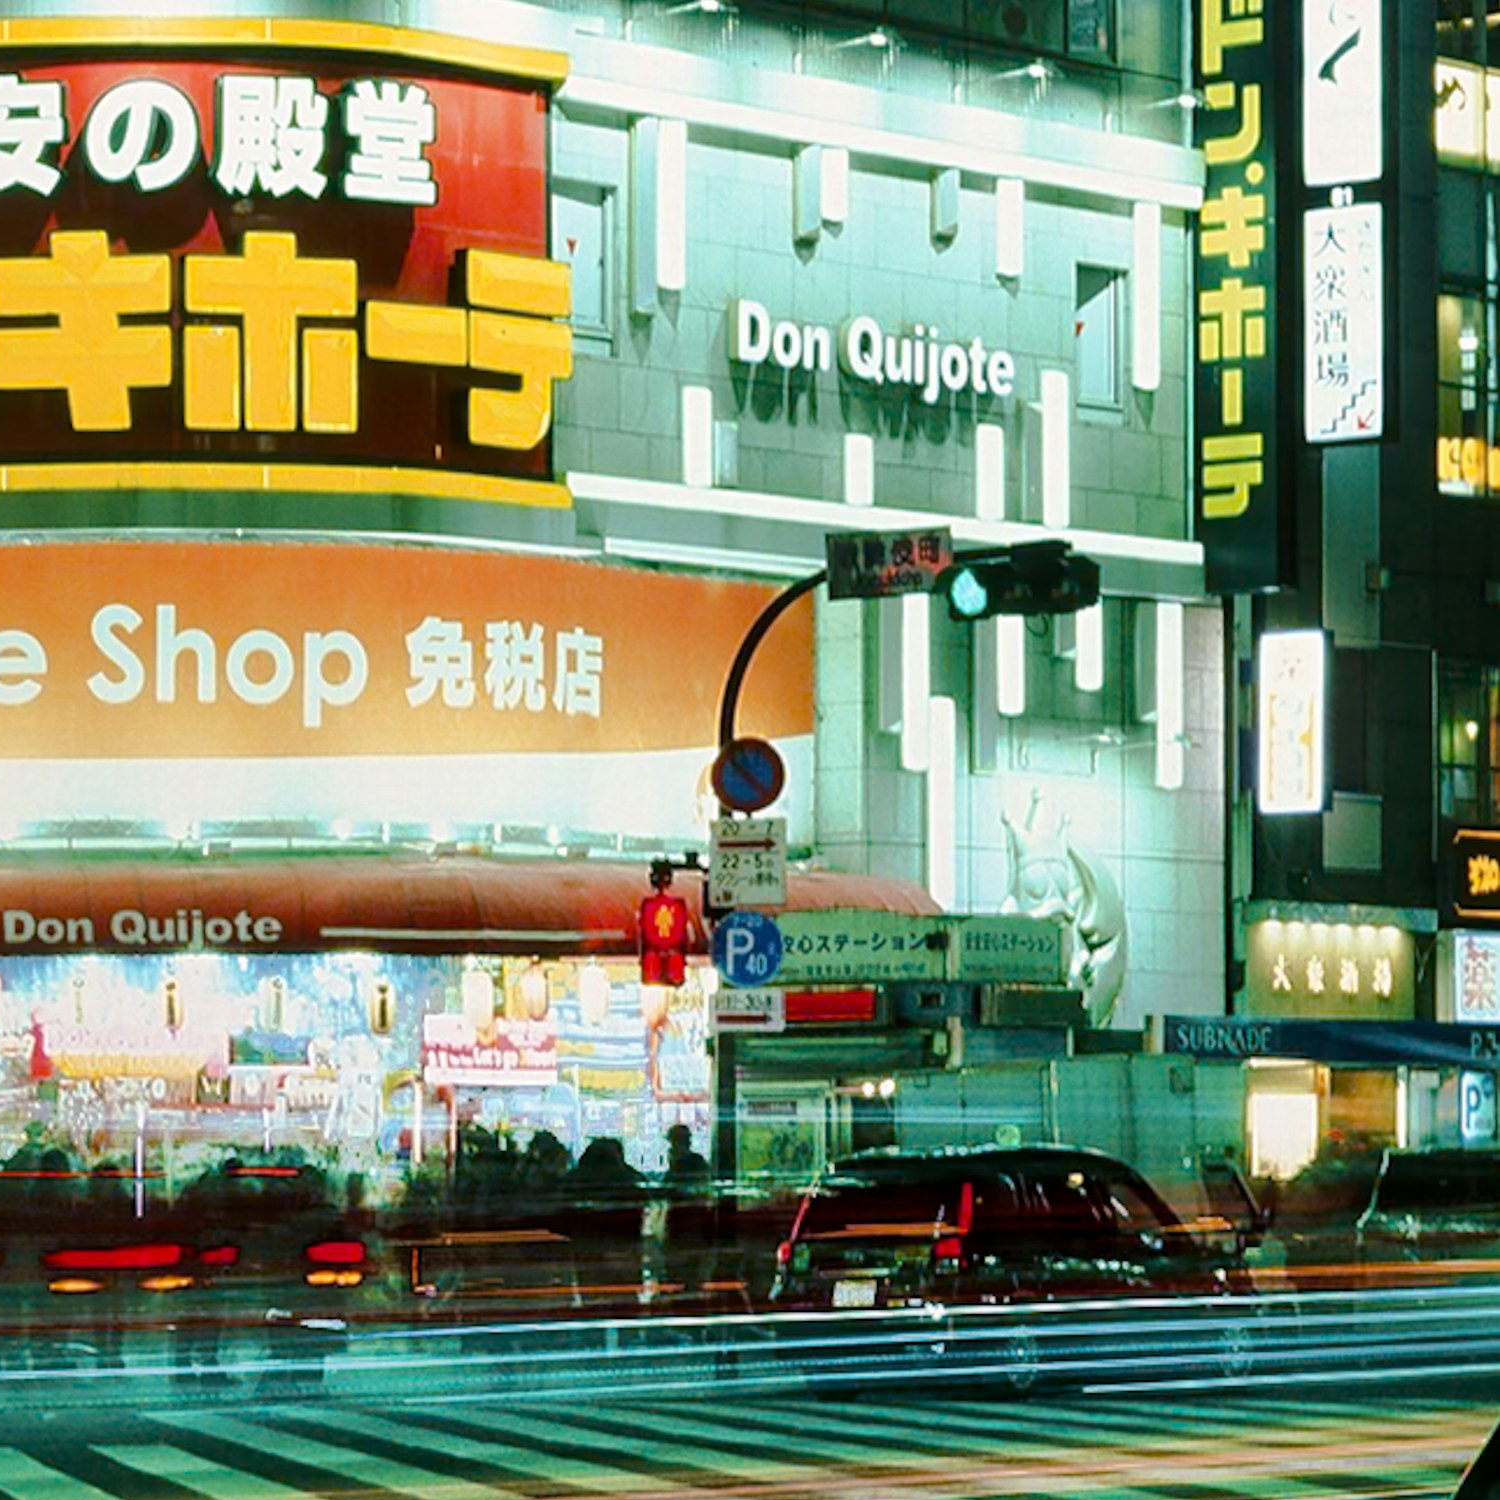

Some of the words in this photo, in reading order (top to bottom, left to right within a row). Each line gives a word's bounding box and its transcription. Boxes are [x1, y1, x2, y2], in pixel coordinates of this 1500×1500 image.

[1314, 221, 1352, 388] 大衆酒場
[736, 299, 830, 371] Don
[846, 315, 1015, 404] Quijote
[86, 604, 367, 728] Shop
[405, 616, 603, 716] 免税店
[3, 910, 93, 944] Don
[110, 910, 283, 947] Quijote
[726, 928, 755, 976] P
[745, 953, 768, 976] 40
[1177, 1025, 1273, 1053] SUBNADE
